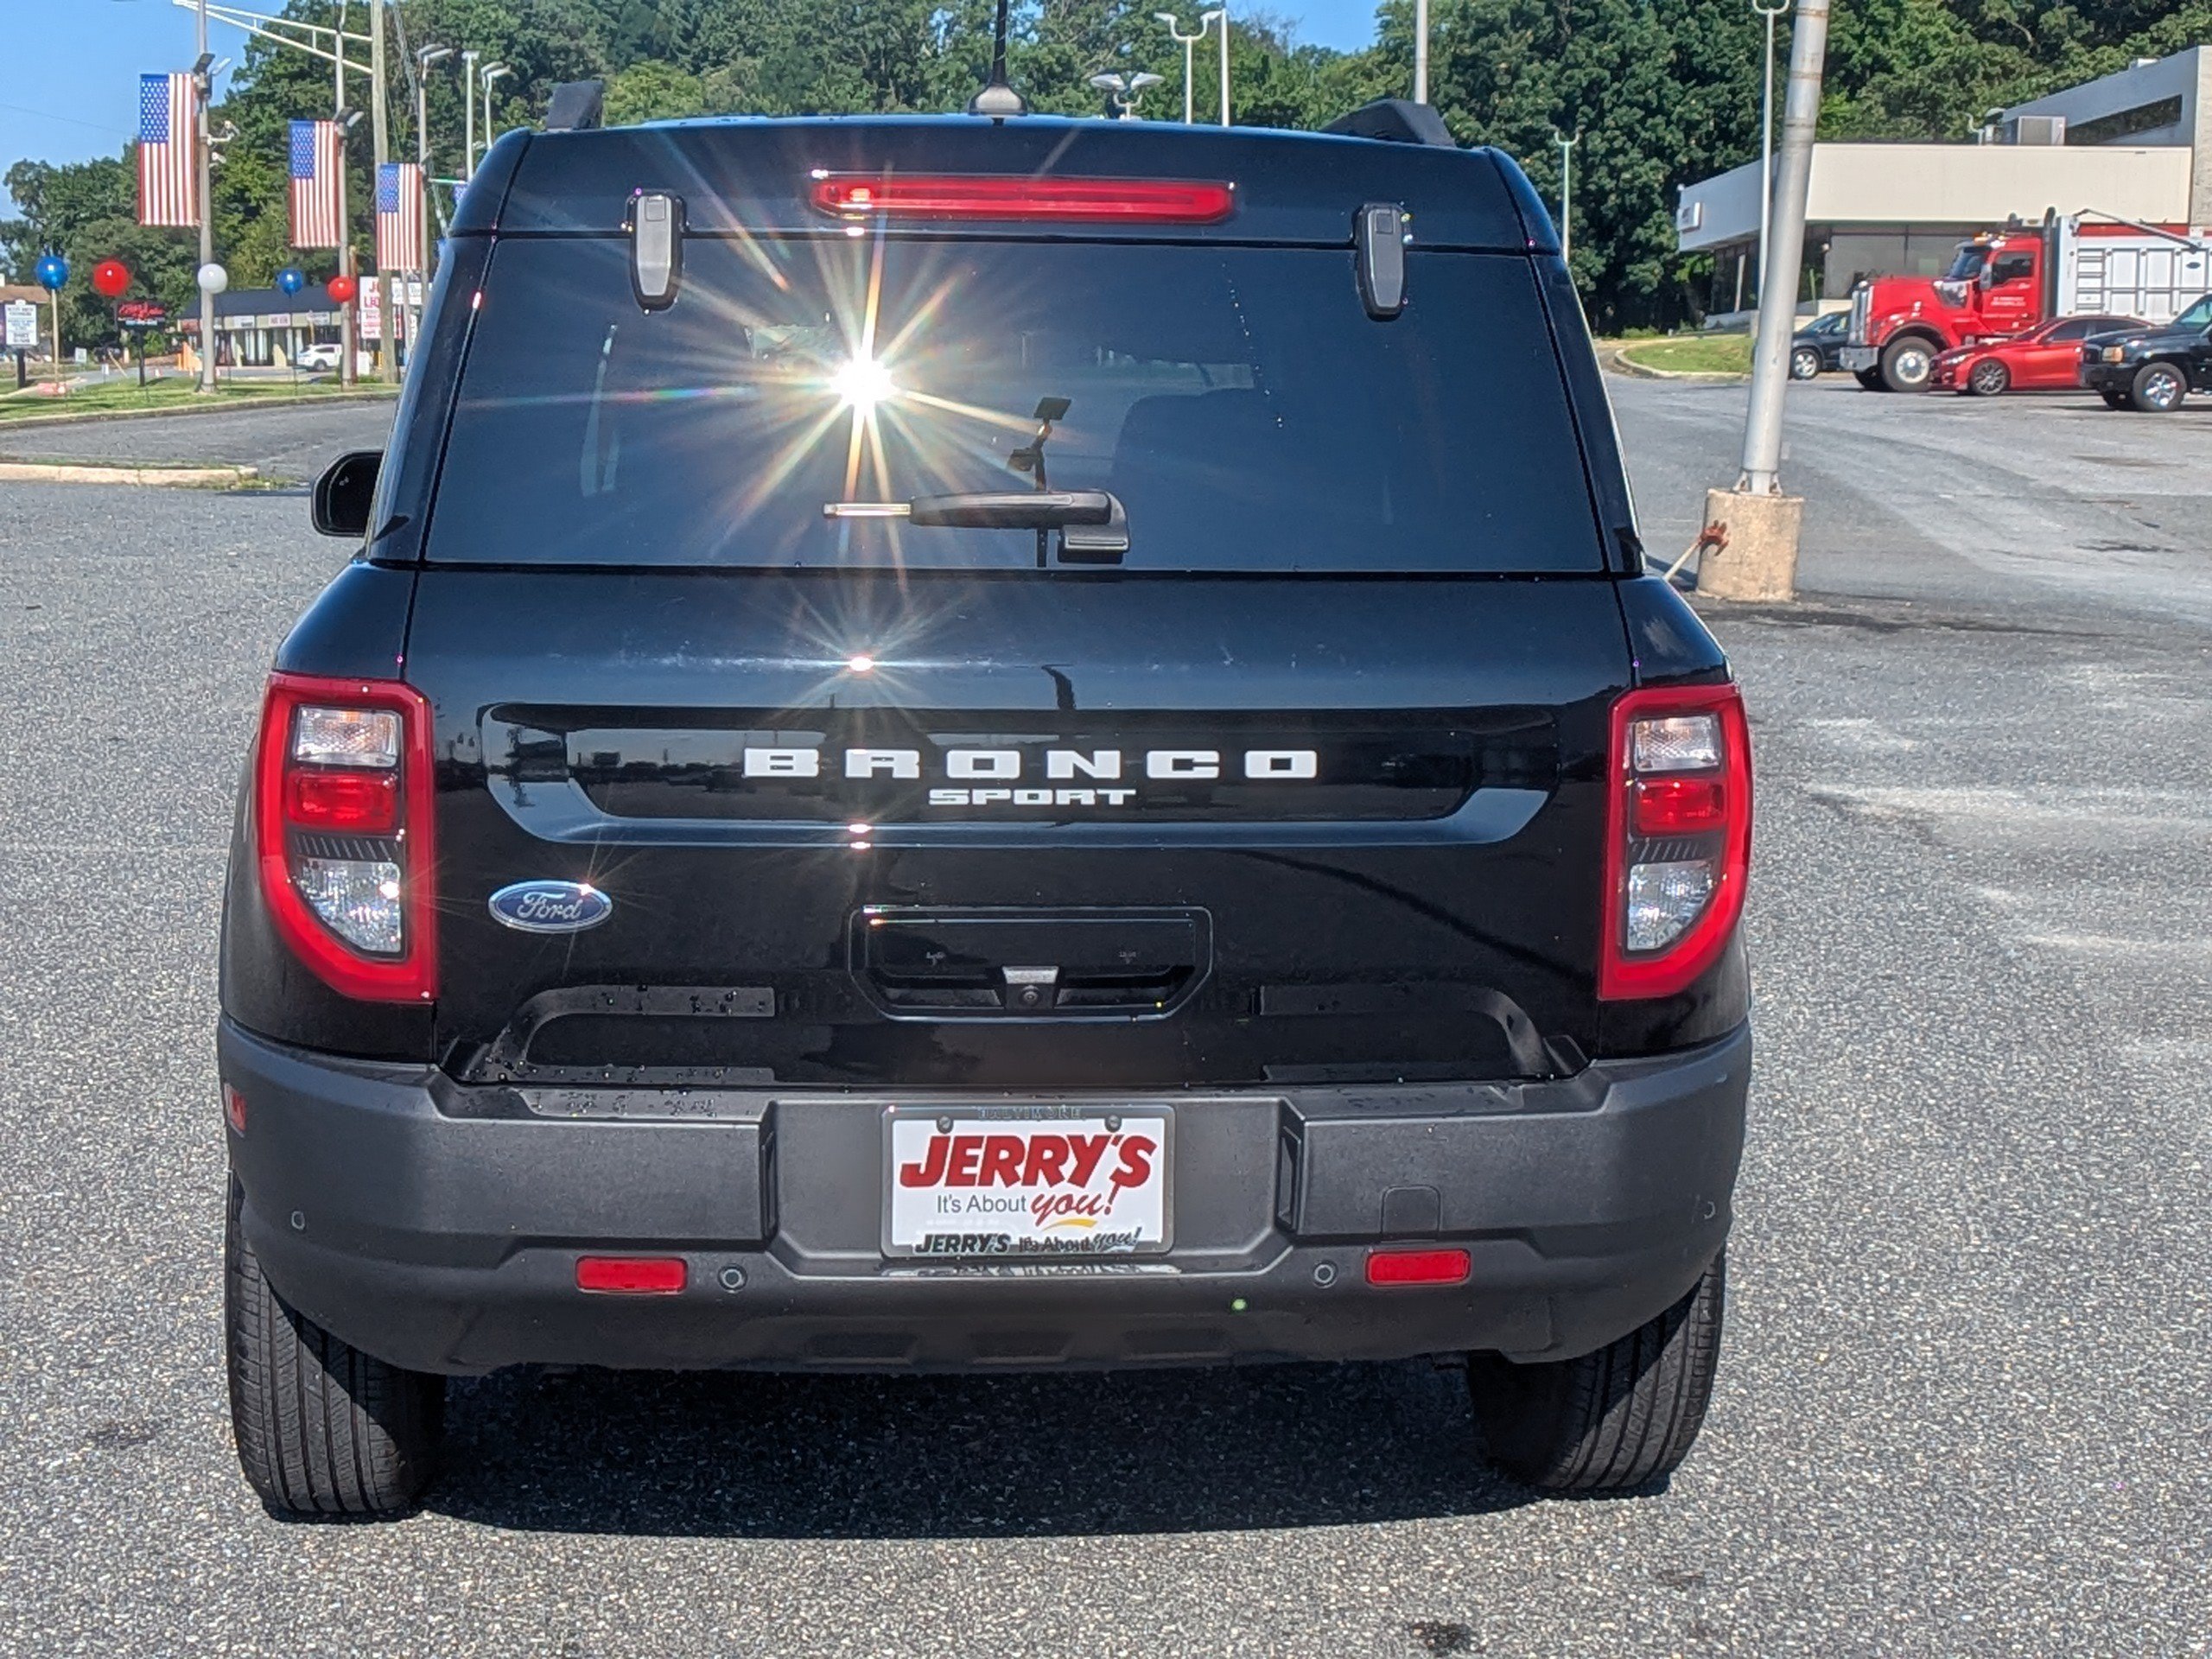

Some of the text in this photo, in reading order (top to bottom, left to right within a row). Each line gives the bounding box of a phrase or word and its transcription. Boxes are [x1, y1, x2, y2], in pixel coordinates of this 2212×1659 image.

[743, 747, 1318, 779] BRONCO
[928, 788, 1137, 805] SPORT
[516, 891, 584, 920] Ford
[899, 1135, 1158, 1188] JERRY'S
[937, 1180, 1122, 1227] It's About you!
[914, 1226, 1142, 1253] JERRY'S It's About you!
